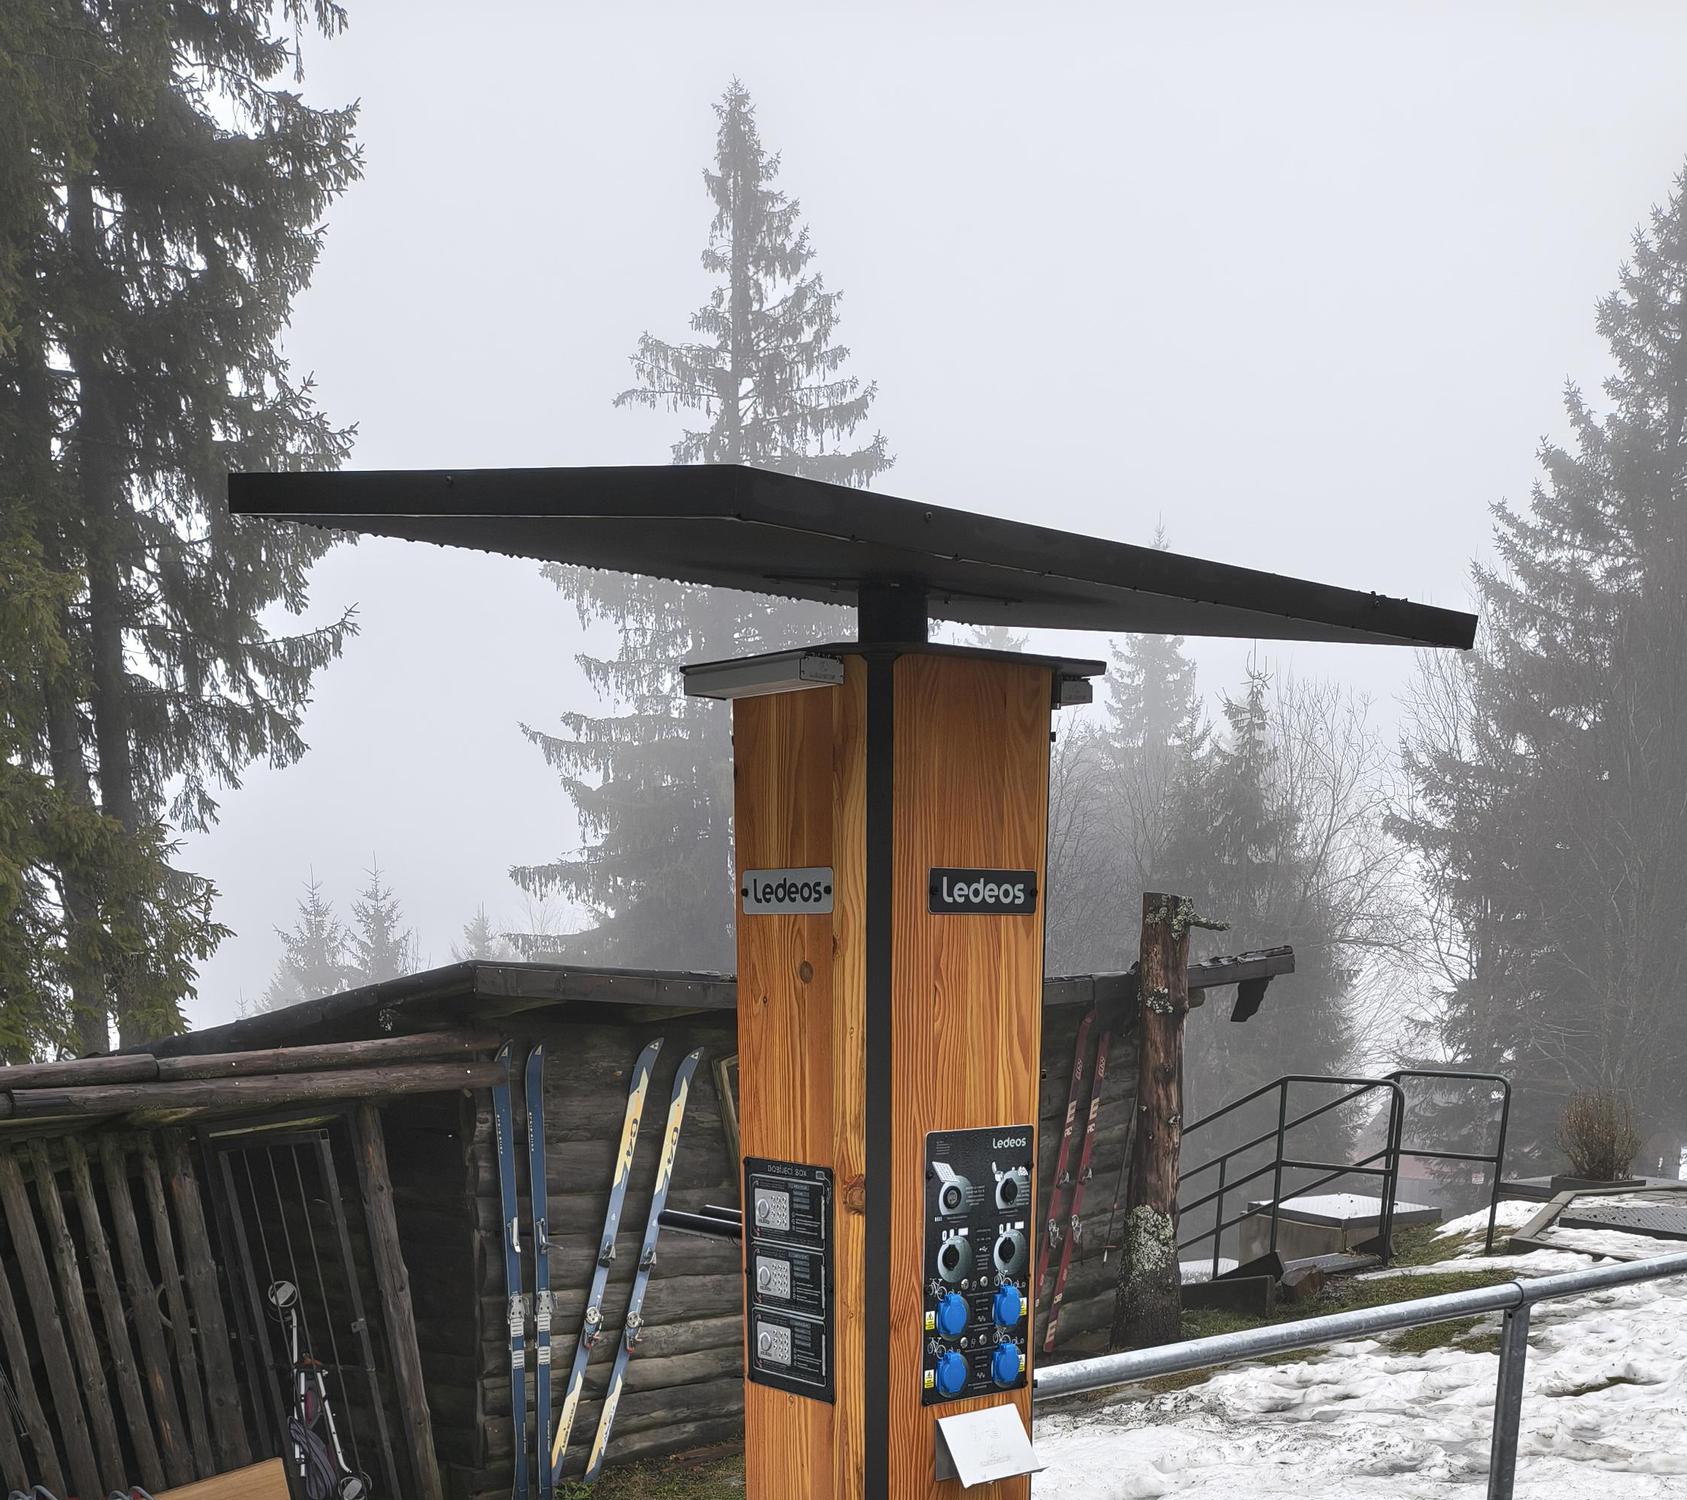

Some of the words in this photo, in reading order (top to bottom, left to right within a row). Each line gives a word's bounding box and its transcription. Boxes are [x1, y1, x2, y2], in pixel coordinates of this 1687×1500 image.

[753, 877, 822, 904] Ledeos
[942, 876, 1025, 904] Ledeos
[992, 1136, 1027, 1149] Ledeos
